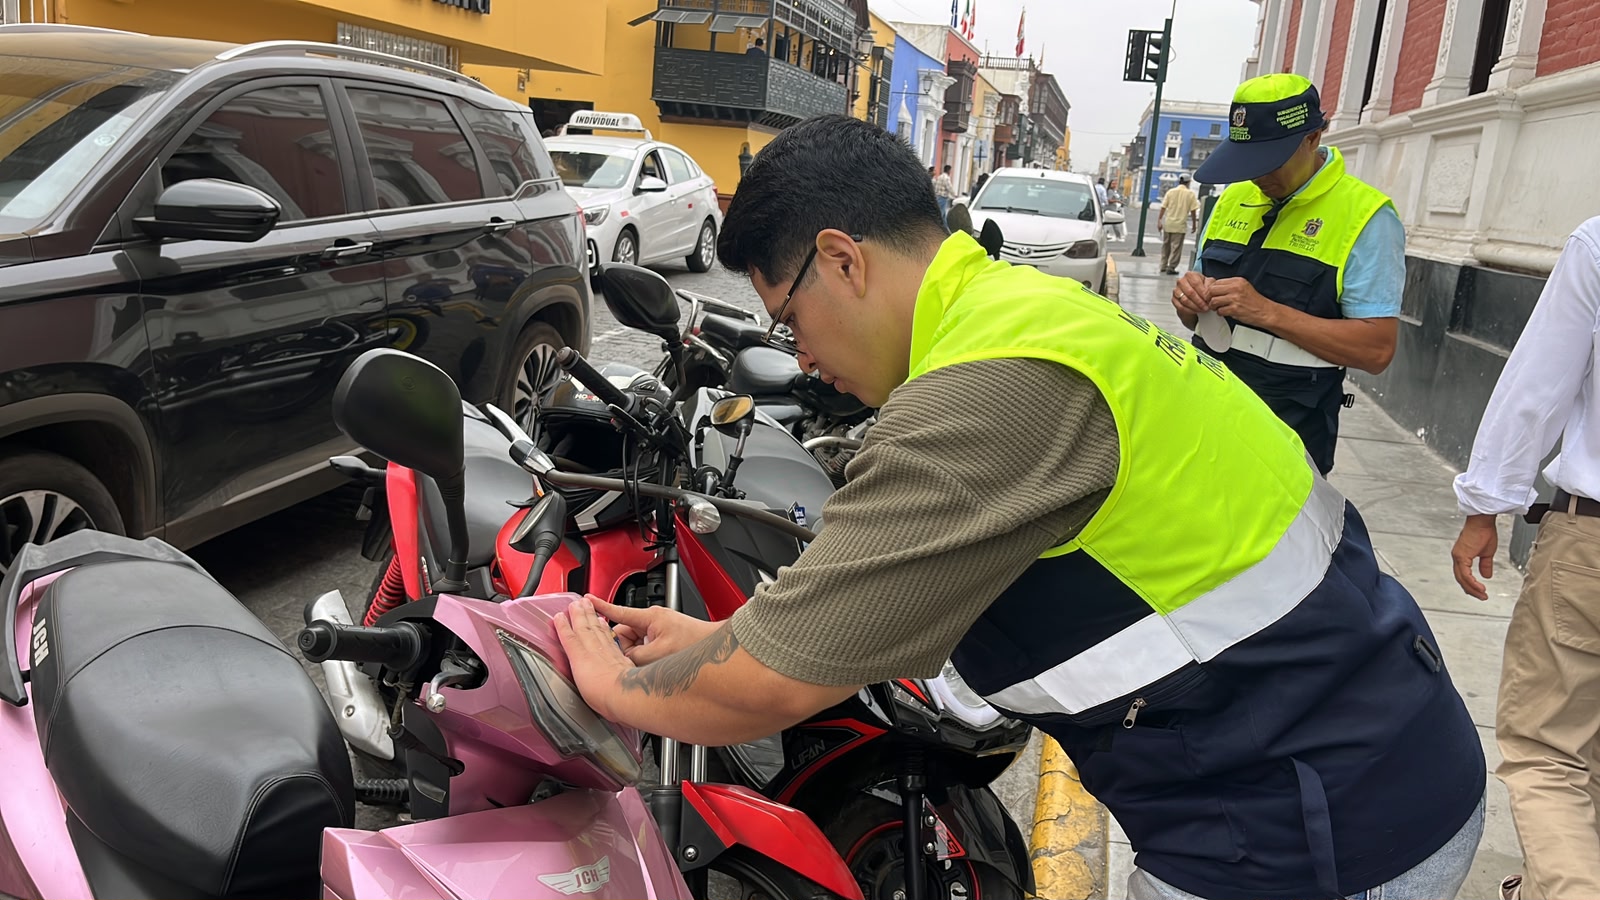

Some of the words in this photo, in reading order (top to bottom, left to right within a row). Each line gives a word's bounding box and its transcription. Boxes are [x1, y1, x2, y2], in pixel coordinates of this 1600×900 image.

[575, 115, 620, 127] INDIVIDUAL
[33, 617, 49, 667] JCH
[791, 739, 826, 770] LIFAN
[575, 869, 600, 888] JCH
